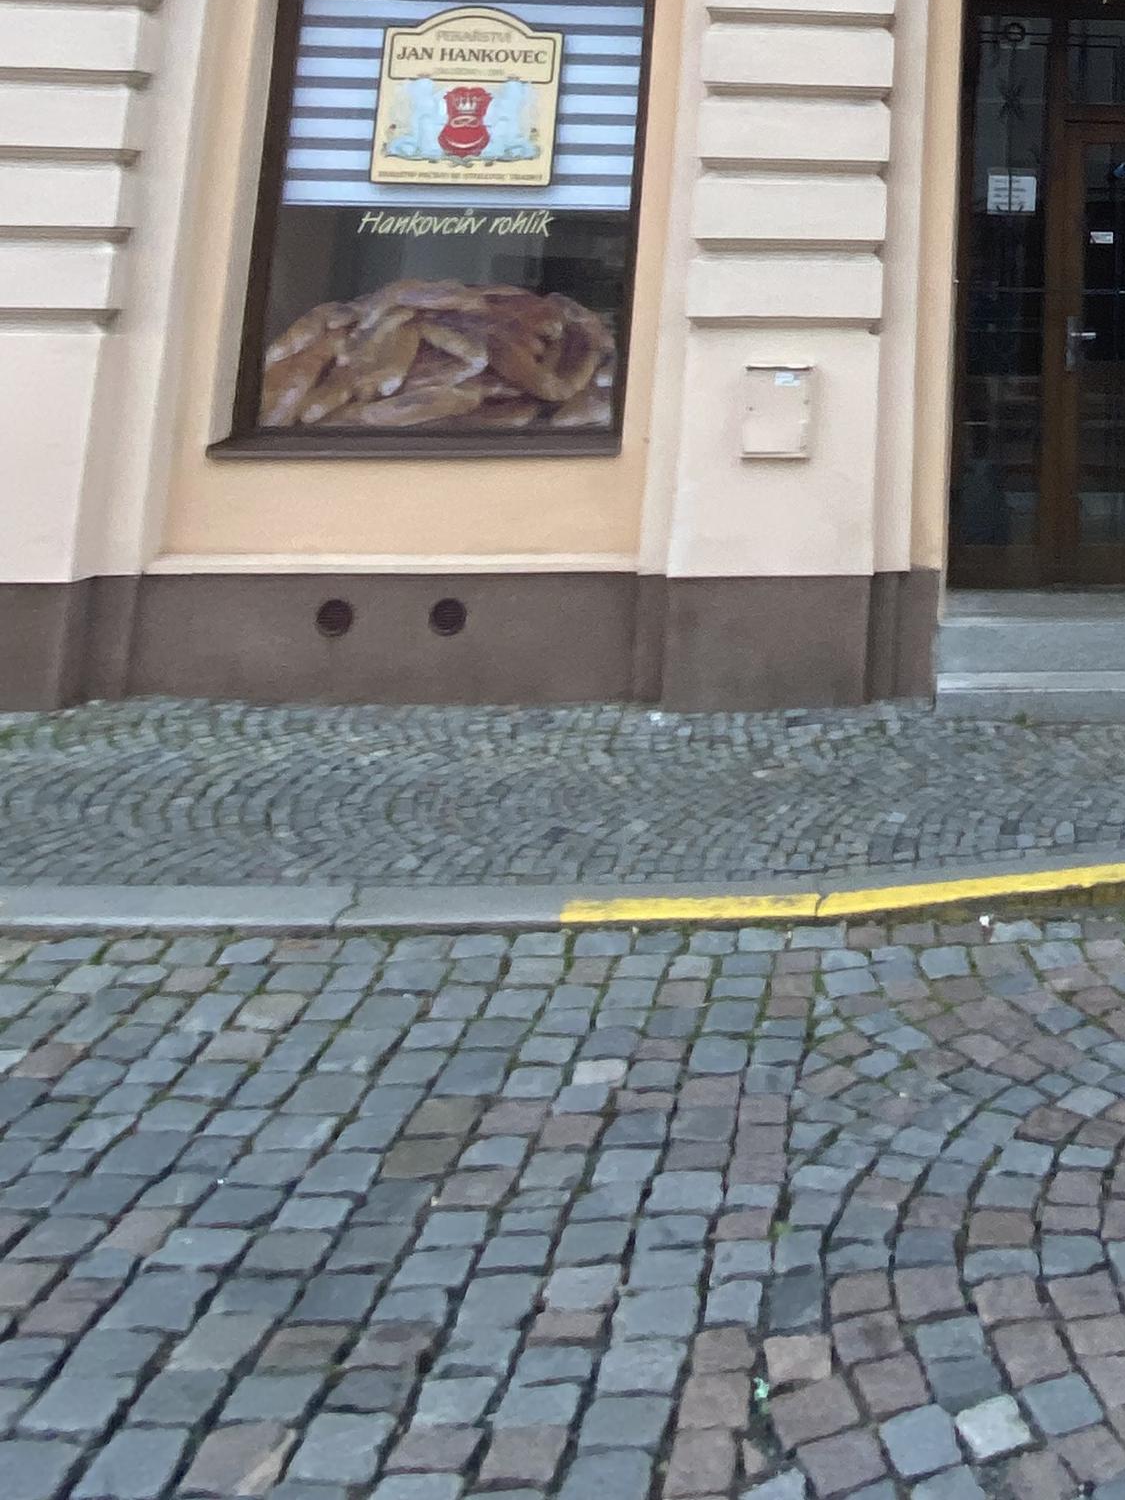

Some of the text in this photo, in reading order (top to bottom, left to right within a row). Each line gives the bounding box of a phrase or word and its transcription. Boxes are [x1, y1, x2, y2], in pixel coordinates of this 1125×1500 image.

[397, 46, 548, 65] JAN HANKOVEC
[357, 208, 554, 237] Hankovcův rohlík
